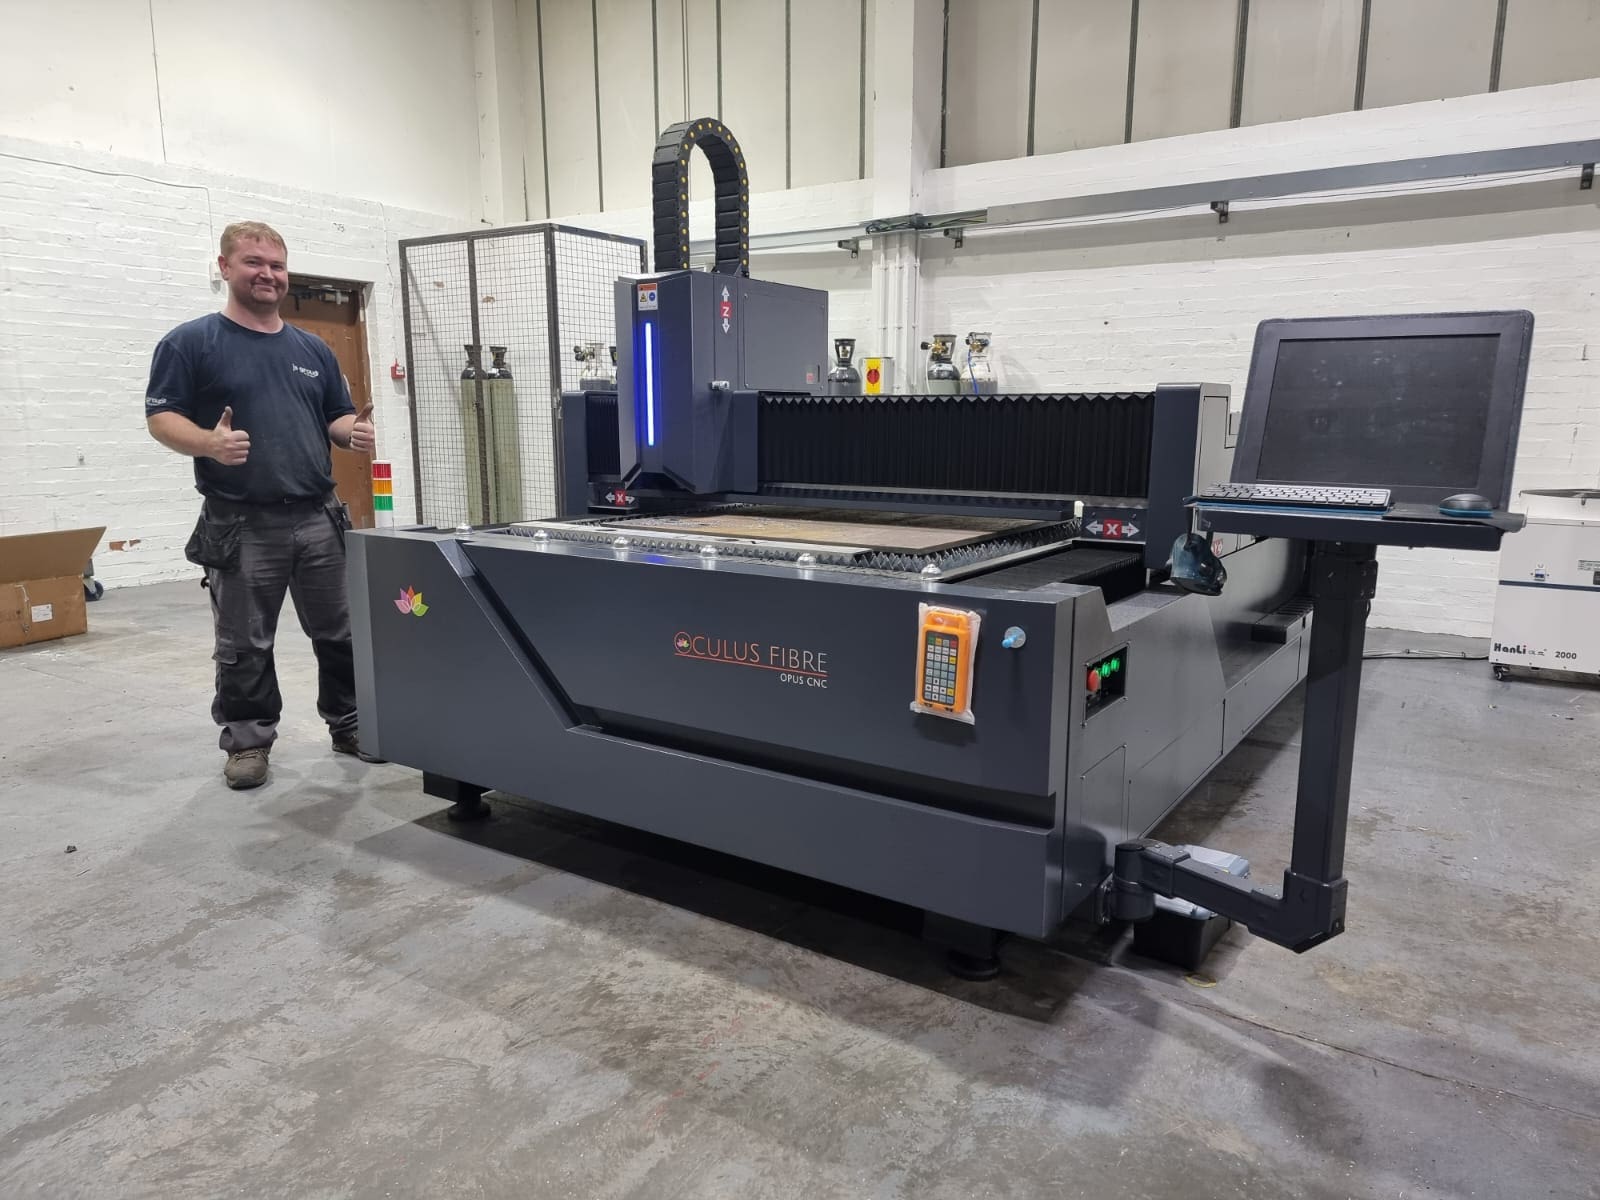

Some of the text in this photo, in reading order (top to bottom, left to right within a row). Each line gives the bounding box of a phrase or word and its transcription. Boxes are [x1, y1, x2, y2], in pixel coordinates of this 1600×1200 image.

[722, 306, 730, 317] Z
[1106, 523, 1119, 536] X
[674, 631, 828, 673] OCULUS FIBRE
[1493, 642, 1527, 655] HanLi
[1555, 651, 1577, 660] 2000
[780, 673, 828, 689] OPUS CNC
